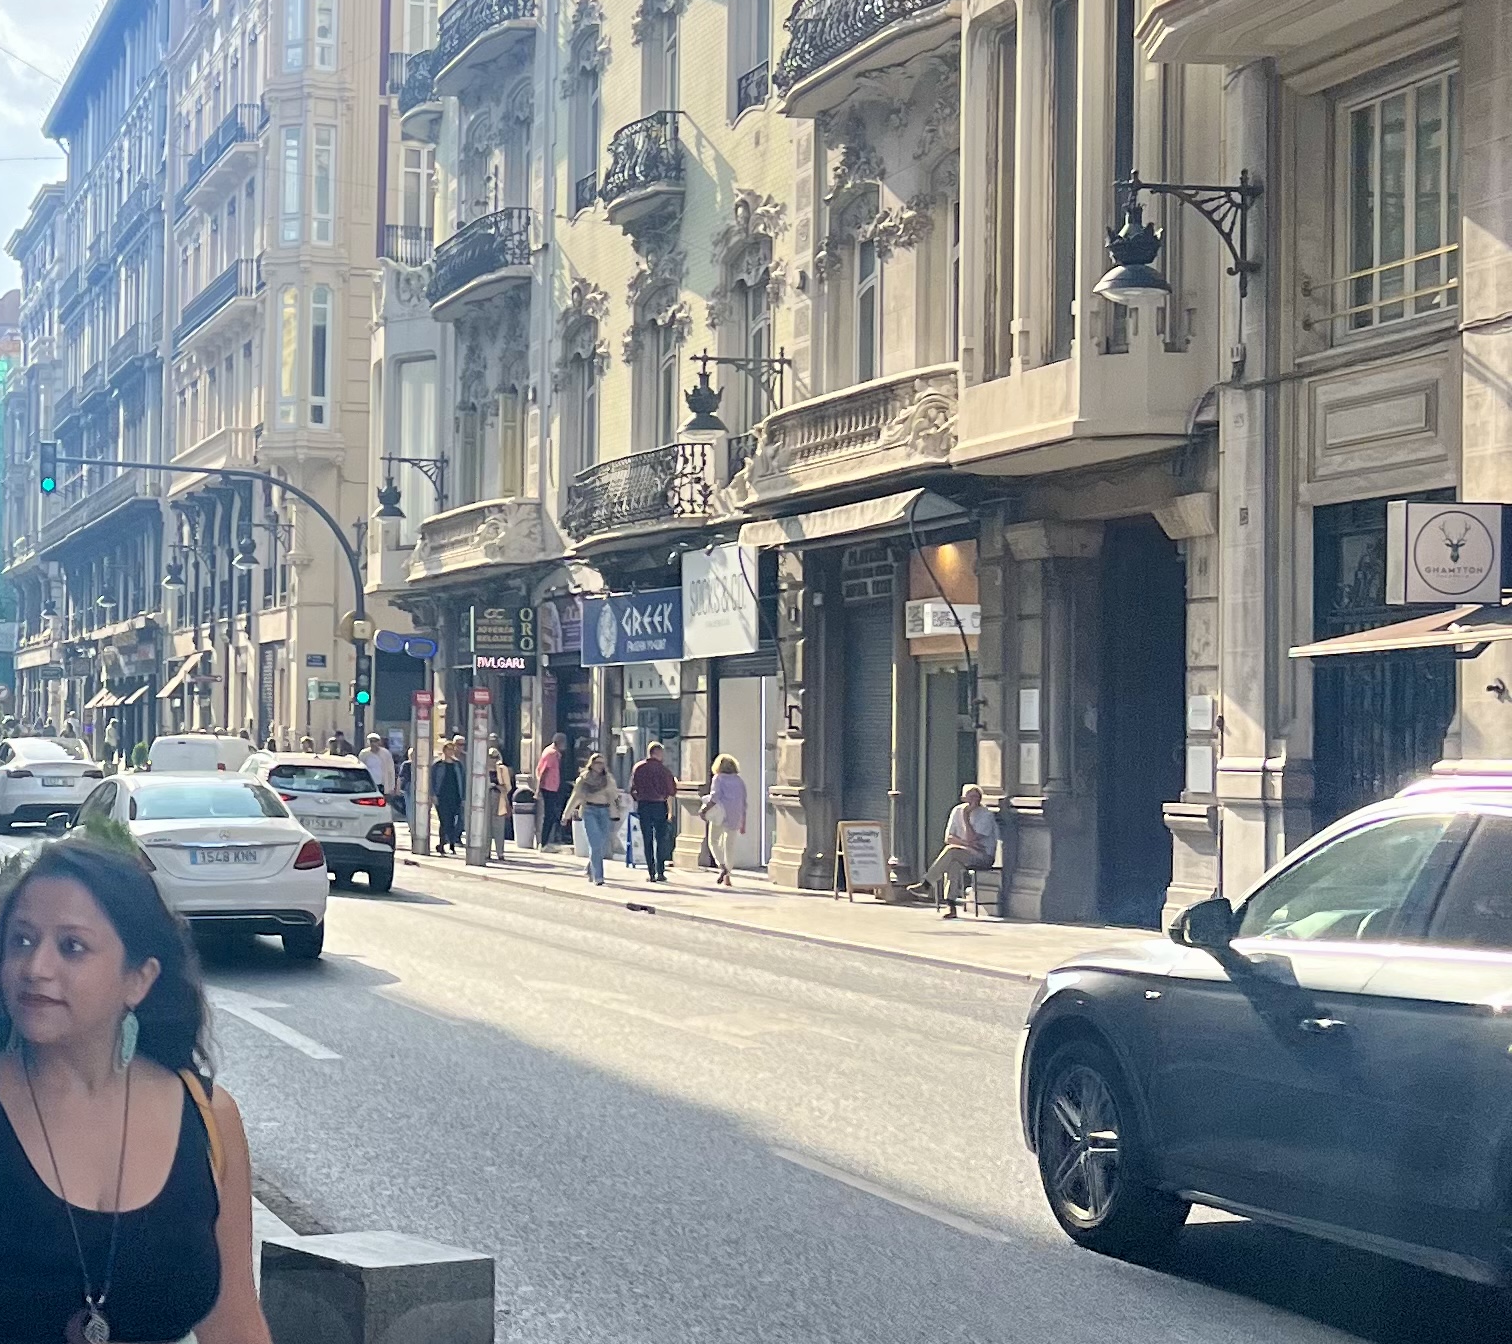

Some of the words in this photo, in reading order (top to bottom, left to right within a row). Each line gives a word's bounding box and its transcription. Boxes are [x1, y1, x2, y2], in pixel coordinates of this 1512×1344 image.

[519, 607, 534, 651] ORO
[620, 602, 673, 637] GREEK
[199, 849, 230, 863] 1548
